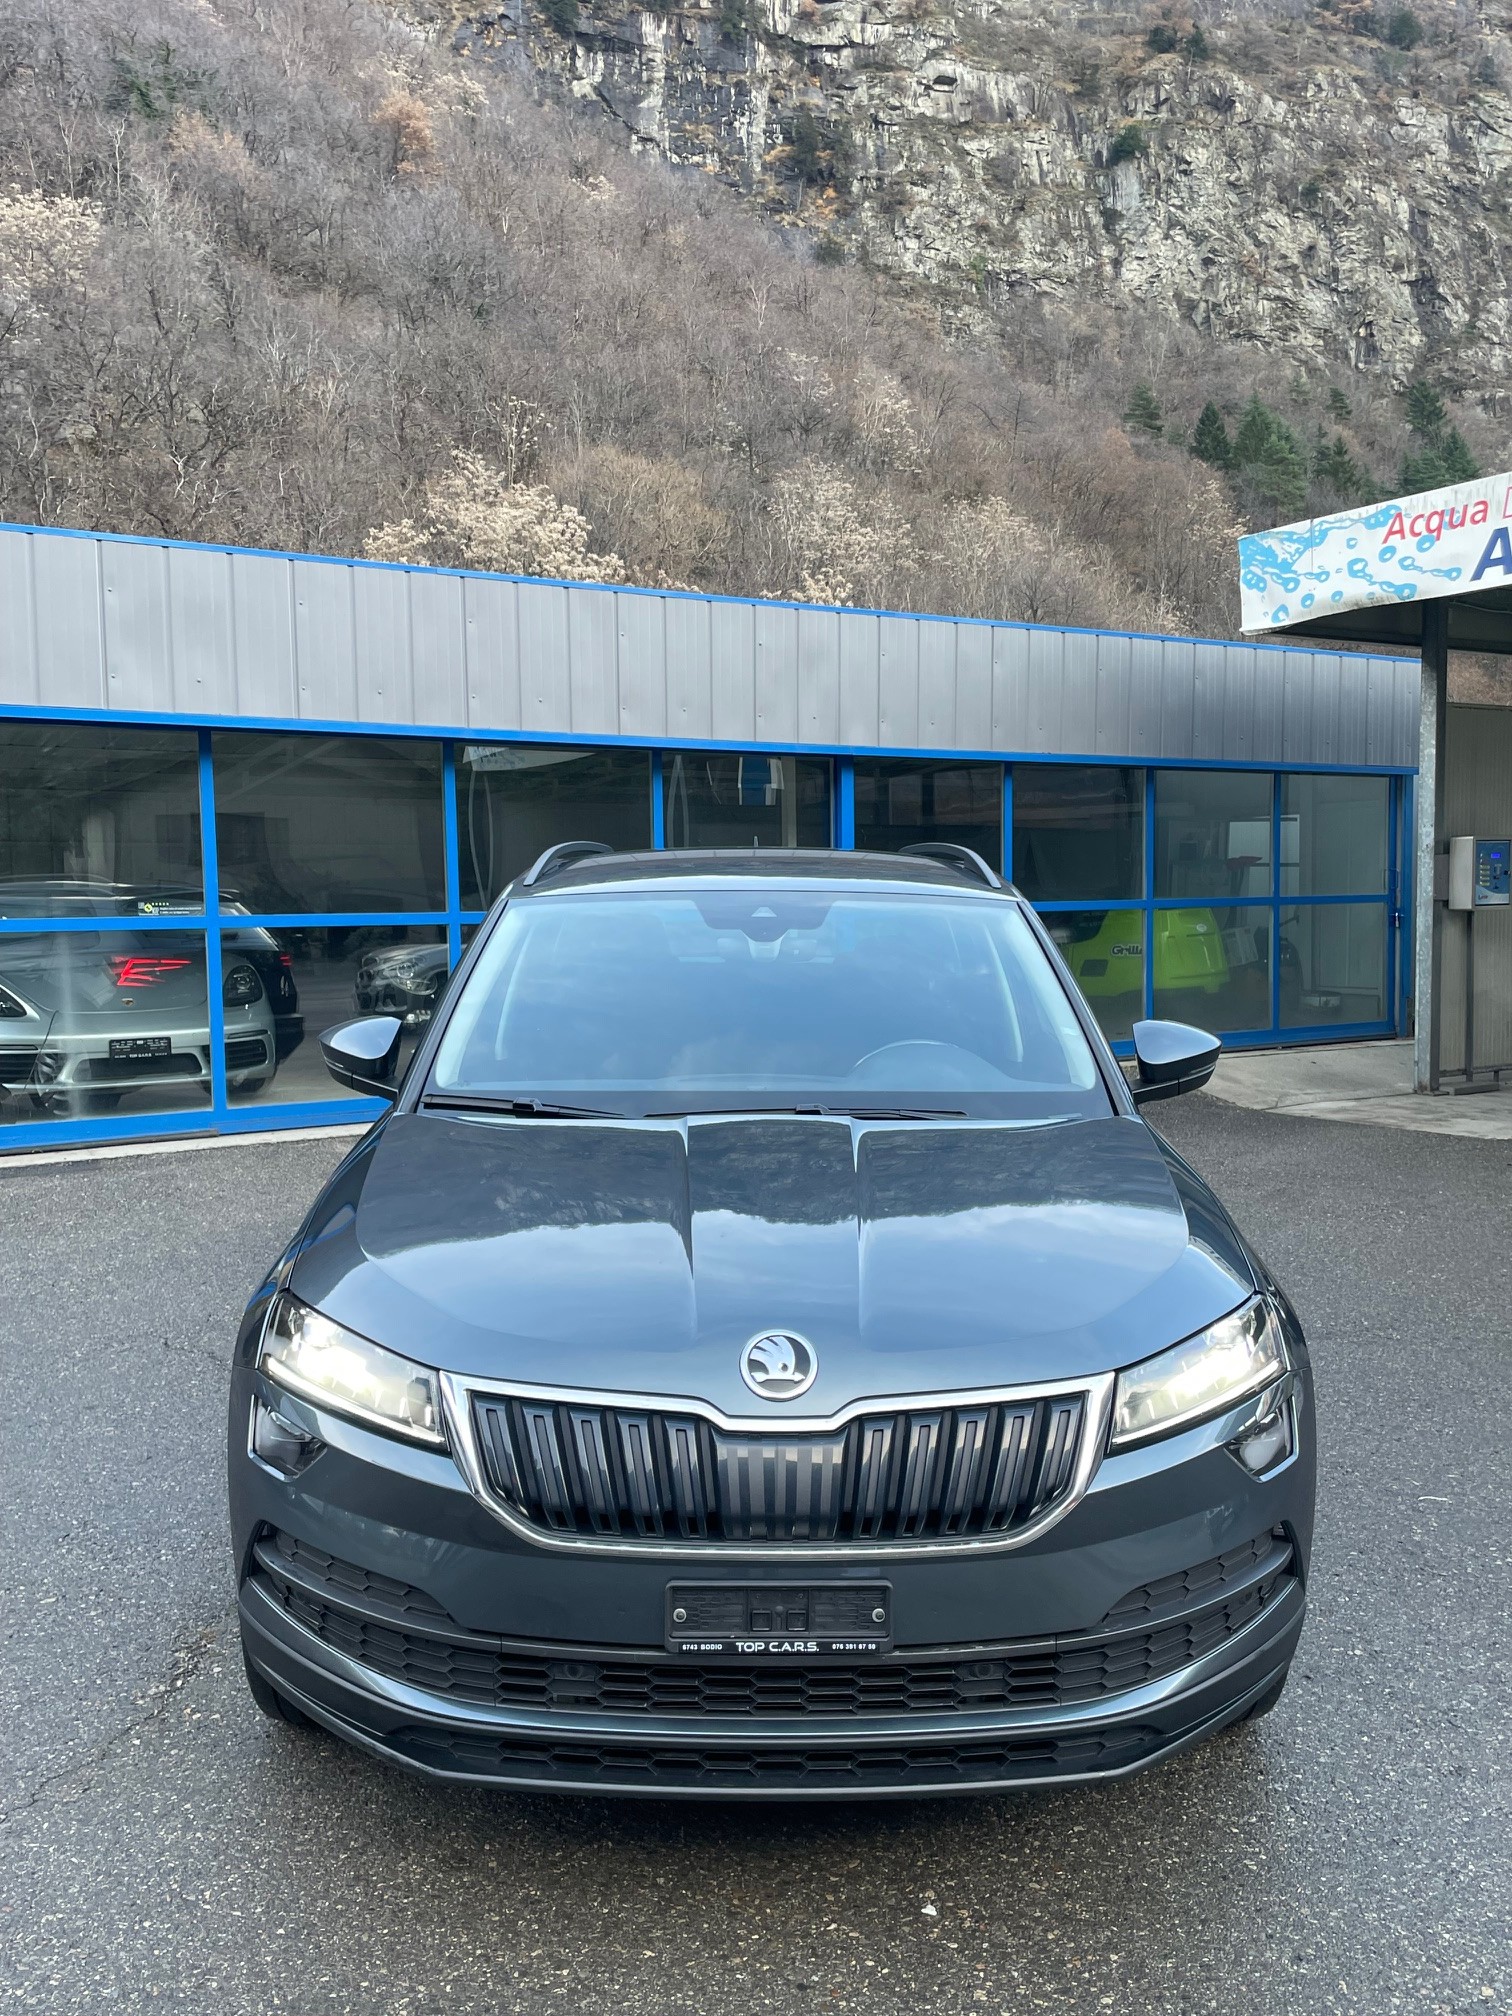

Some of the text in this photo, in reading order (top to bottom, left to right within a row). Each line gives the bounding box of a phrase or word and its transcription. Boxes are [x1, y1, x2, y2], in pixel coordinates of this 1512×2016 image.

[1382, 500, 1488, 544] Acqua
[682, 1643, 723, 1651] 6743 BODIO
[735, 1642, 819, 1652] TOP C.A.R.S.
